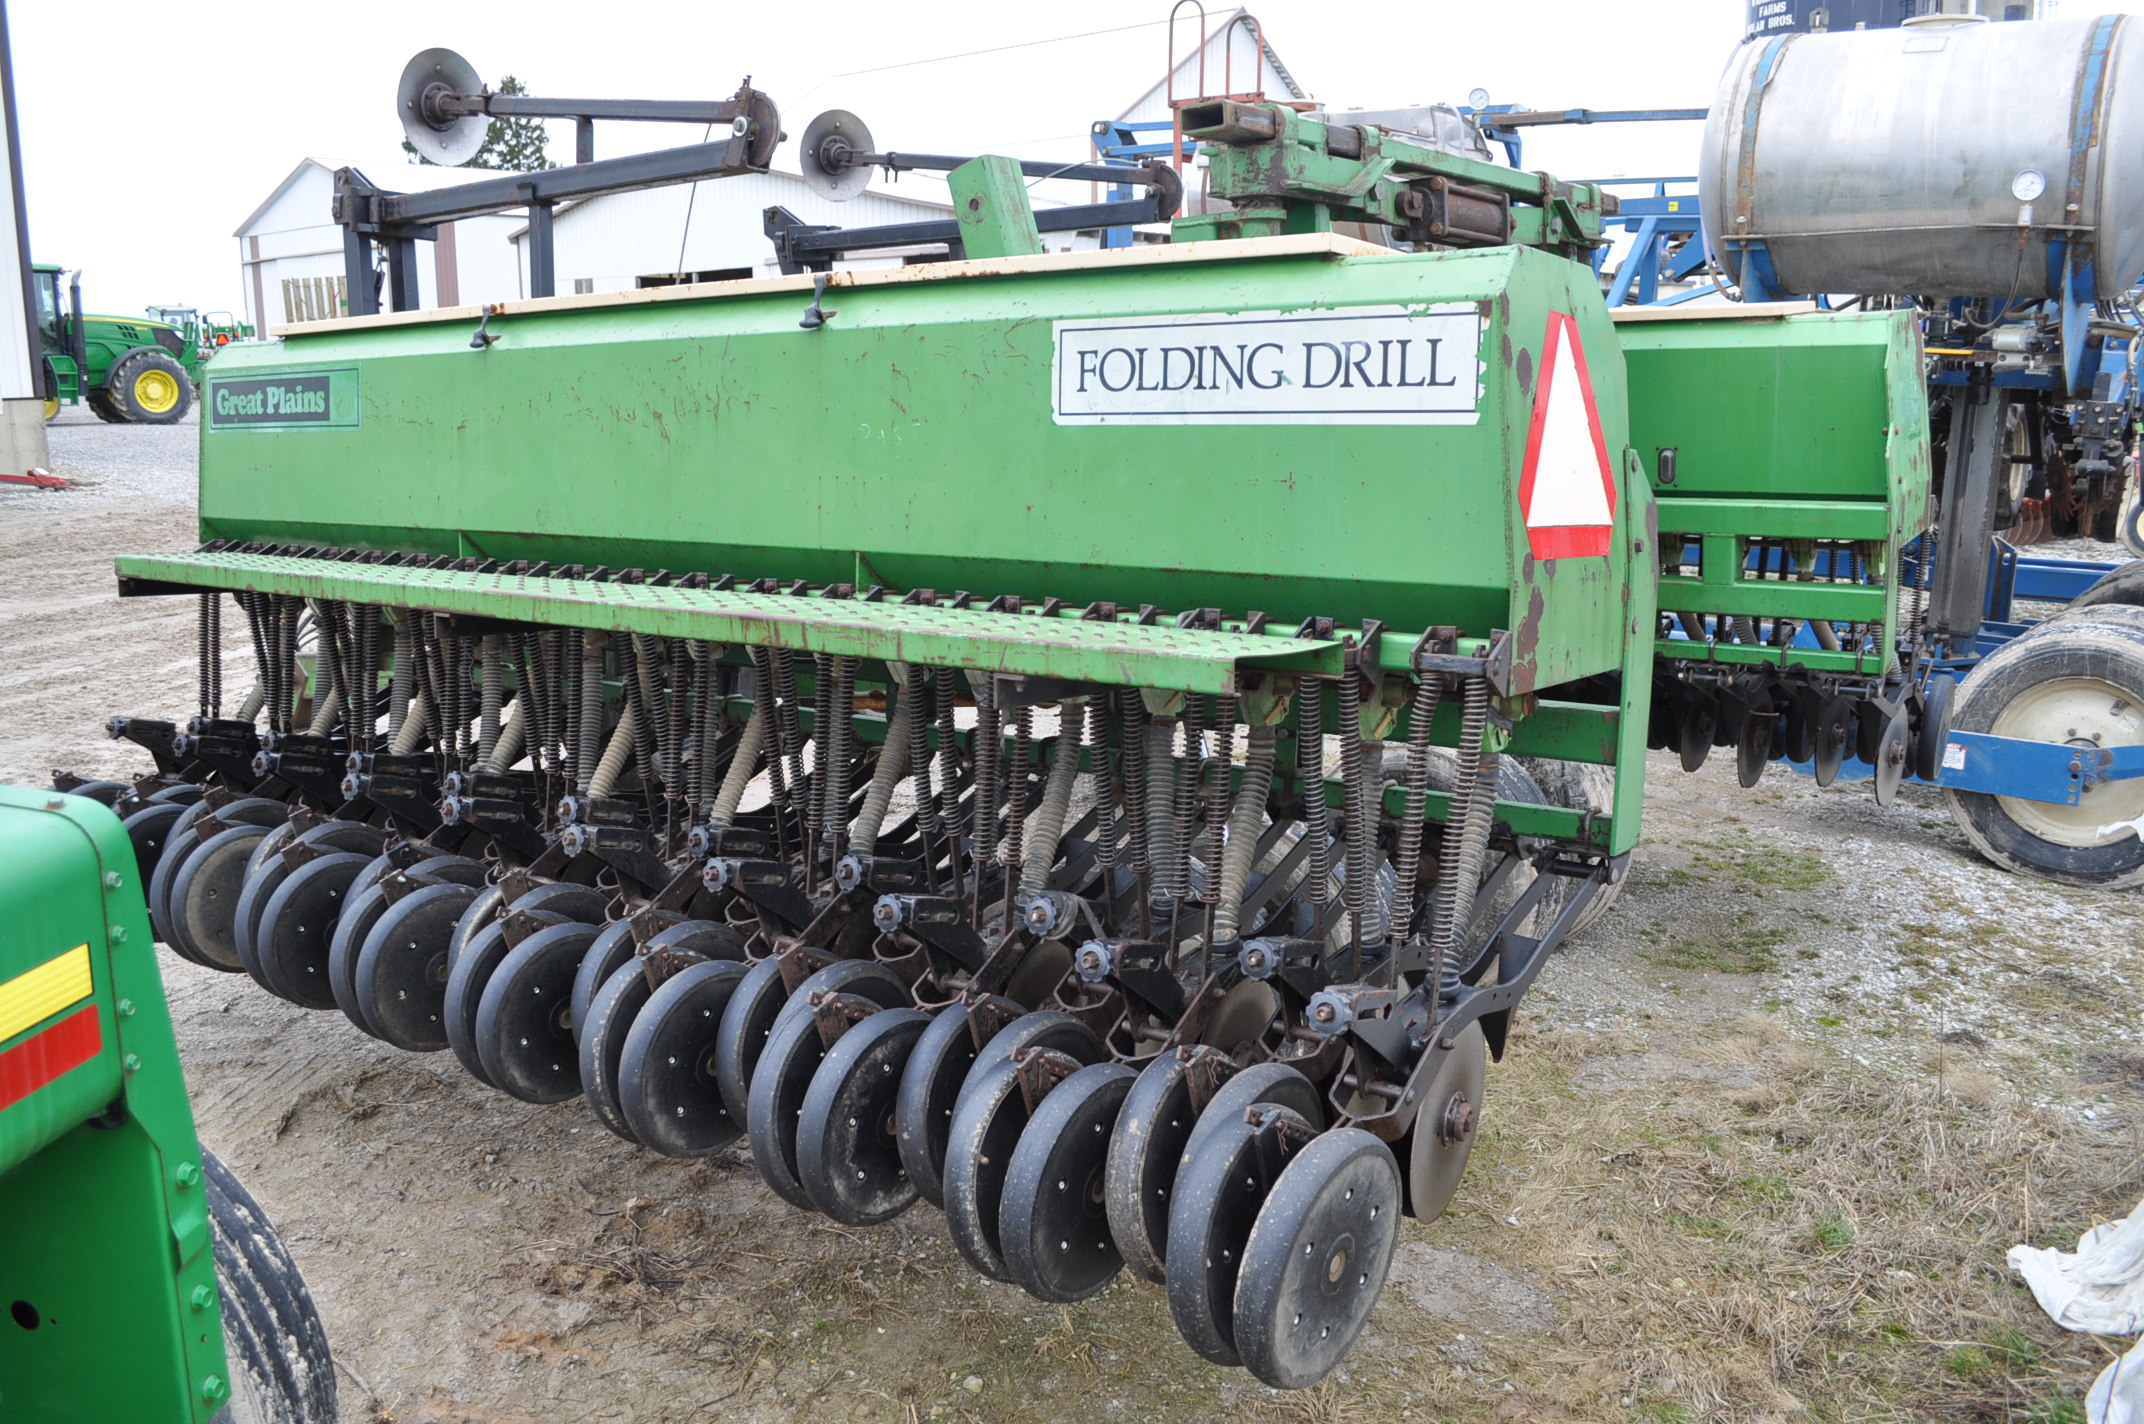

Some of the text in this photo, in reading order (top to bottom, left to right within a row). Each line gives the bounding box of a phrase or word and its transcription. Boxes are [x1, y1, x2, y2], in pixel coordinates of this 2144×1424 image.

[1759, 1, 1787, 18] FARMS
[1768, 13, 1796, 29] BROS.
[1076, 338, 1457, 393] FOLDING DRILL
[216, 385, 326, 416] Great Plains
